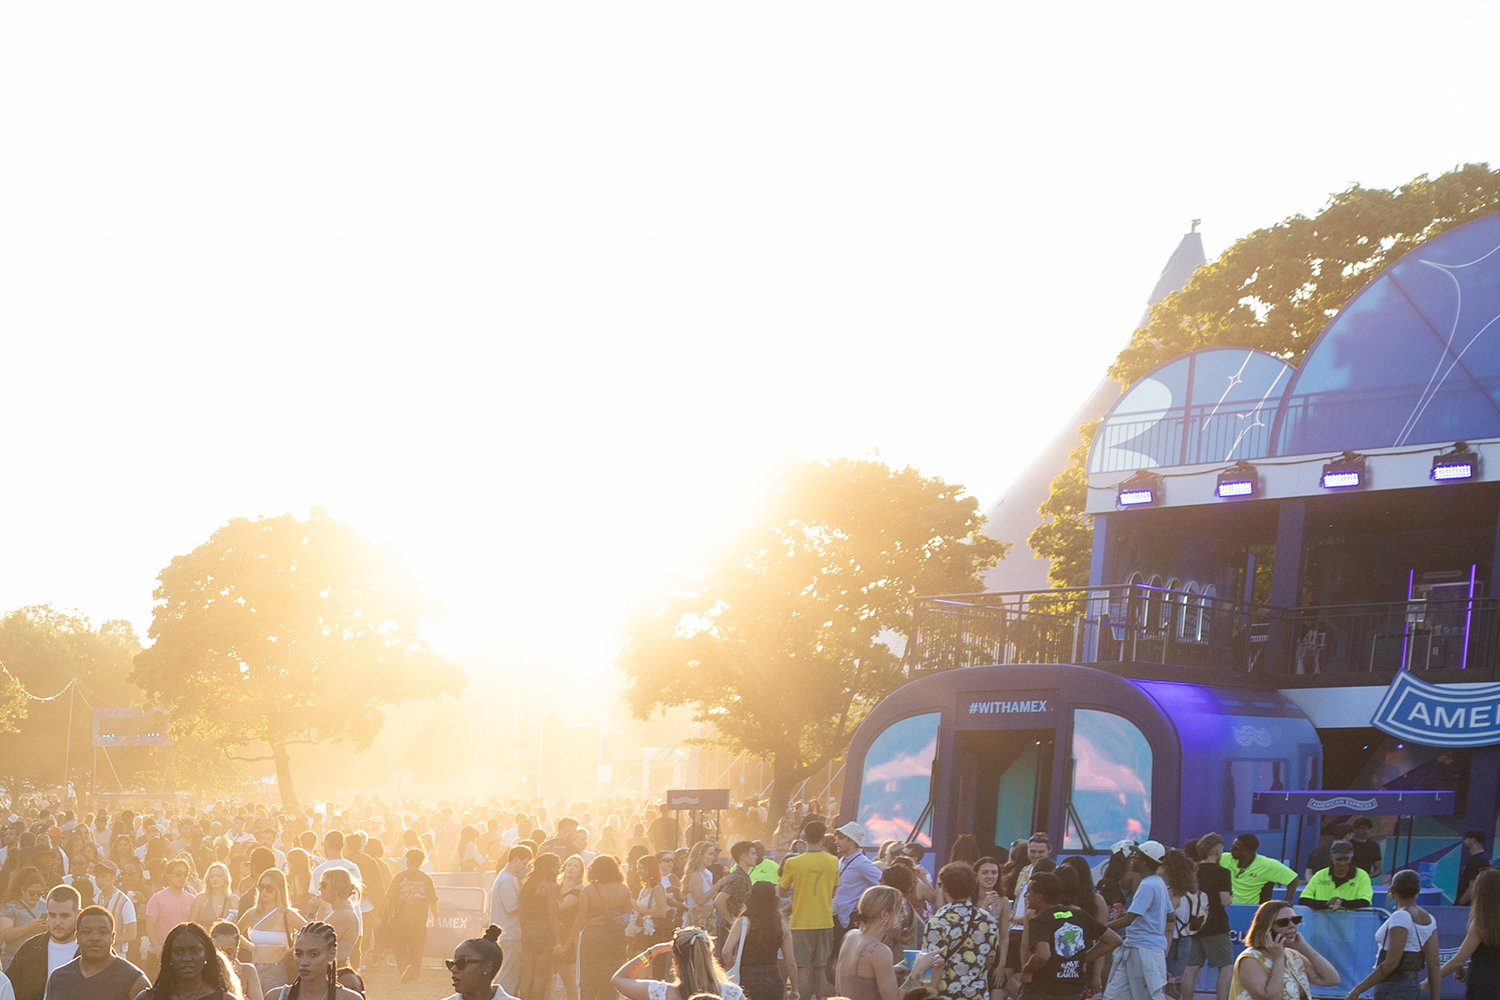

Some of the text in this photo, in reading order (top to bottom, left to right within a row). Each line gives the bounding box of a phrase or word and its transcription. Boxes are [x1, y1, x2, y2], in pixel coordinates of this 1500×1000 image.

[968, 700, 1048, 714] #WITHAMEX
[1407, 701, 1500, 729] AME
[1312, 799, 1372, 808] AMERICAN EXPRESS
[809, 870, 823, 897] 7
[1060, 960, 1080, 968] SAVE
[1063, 966, 1076, 974] THE
